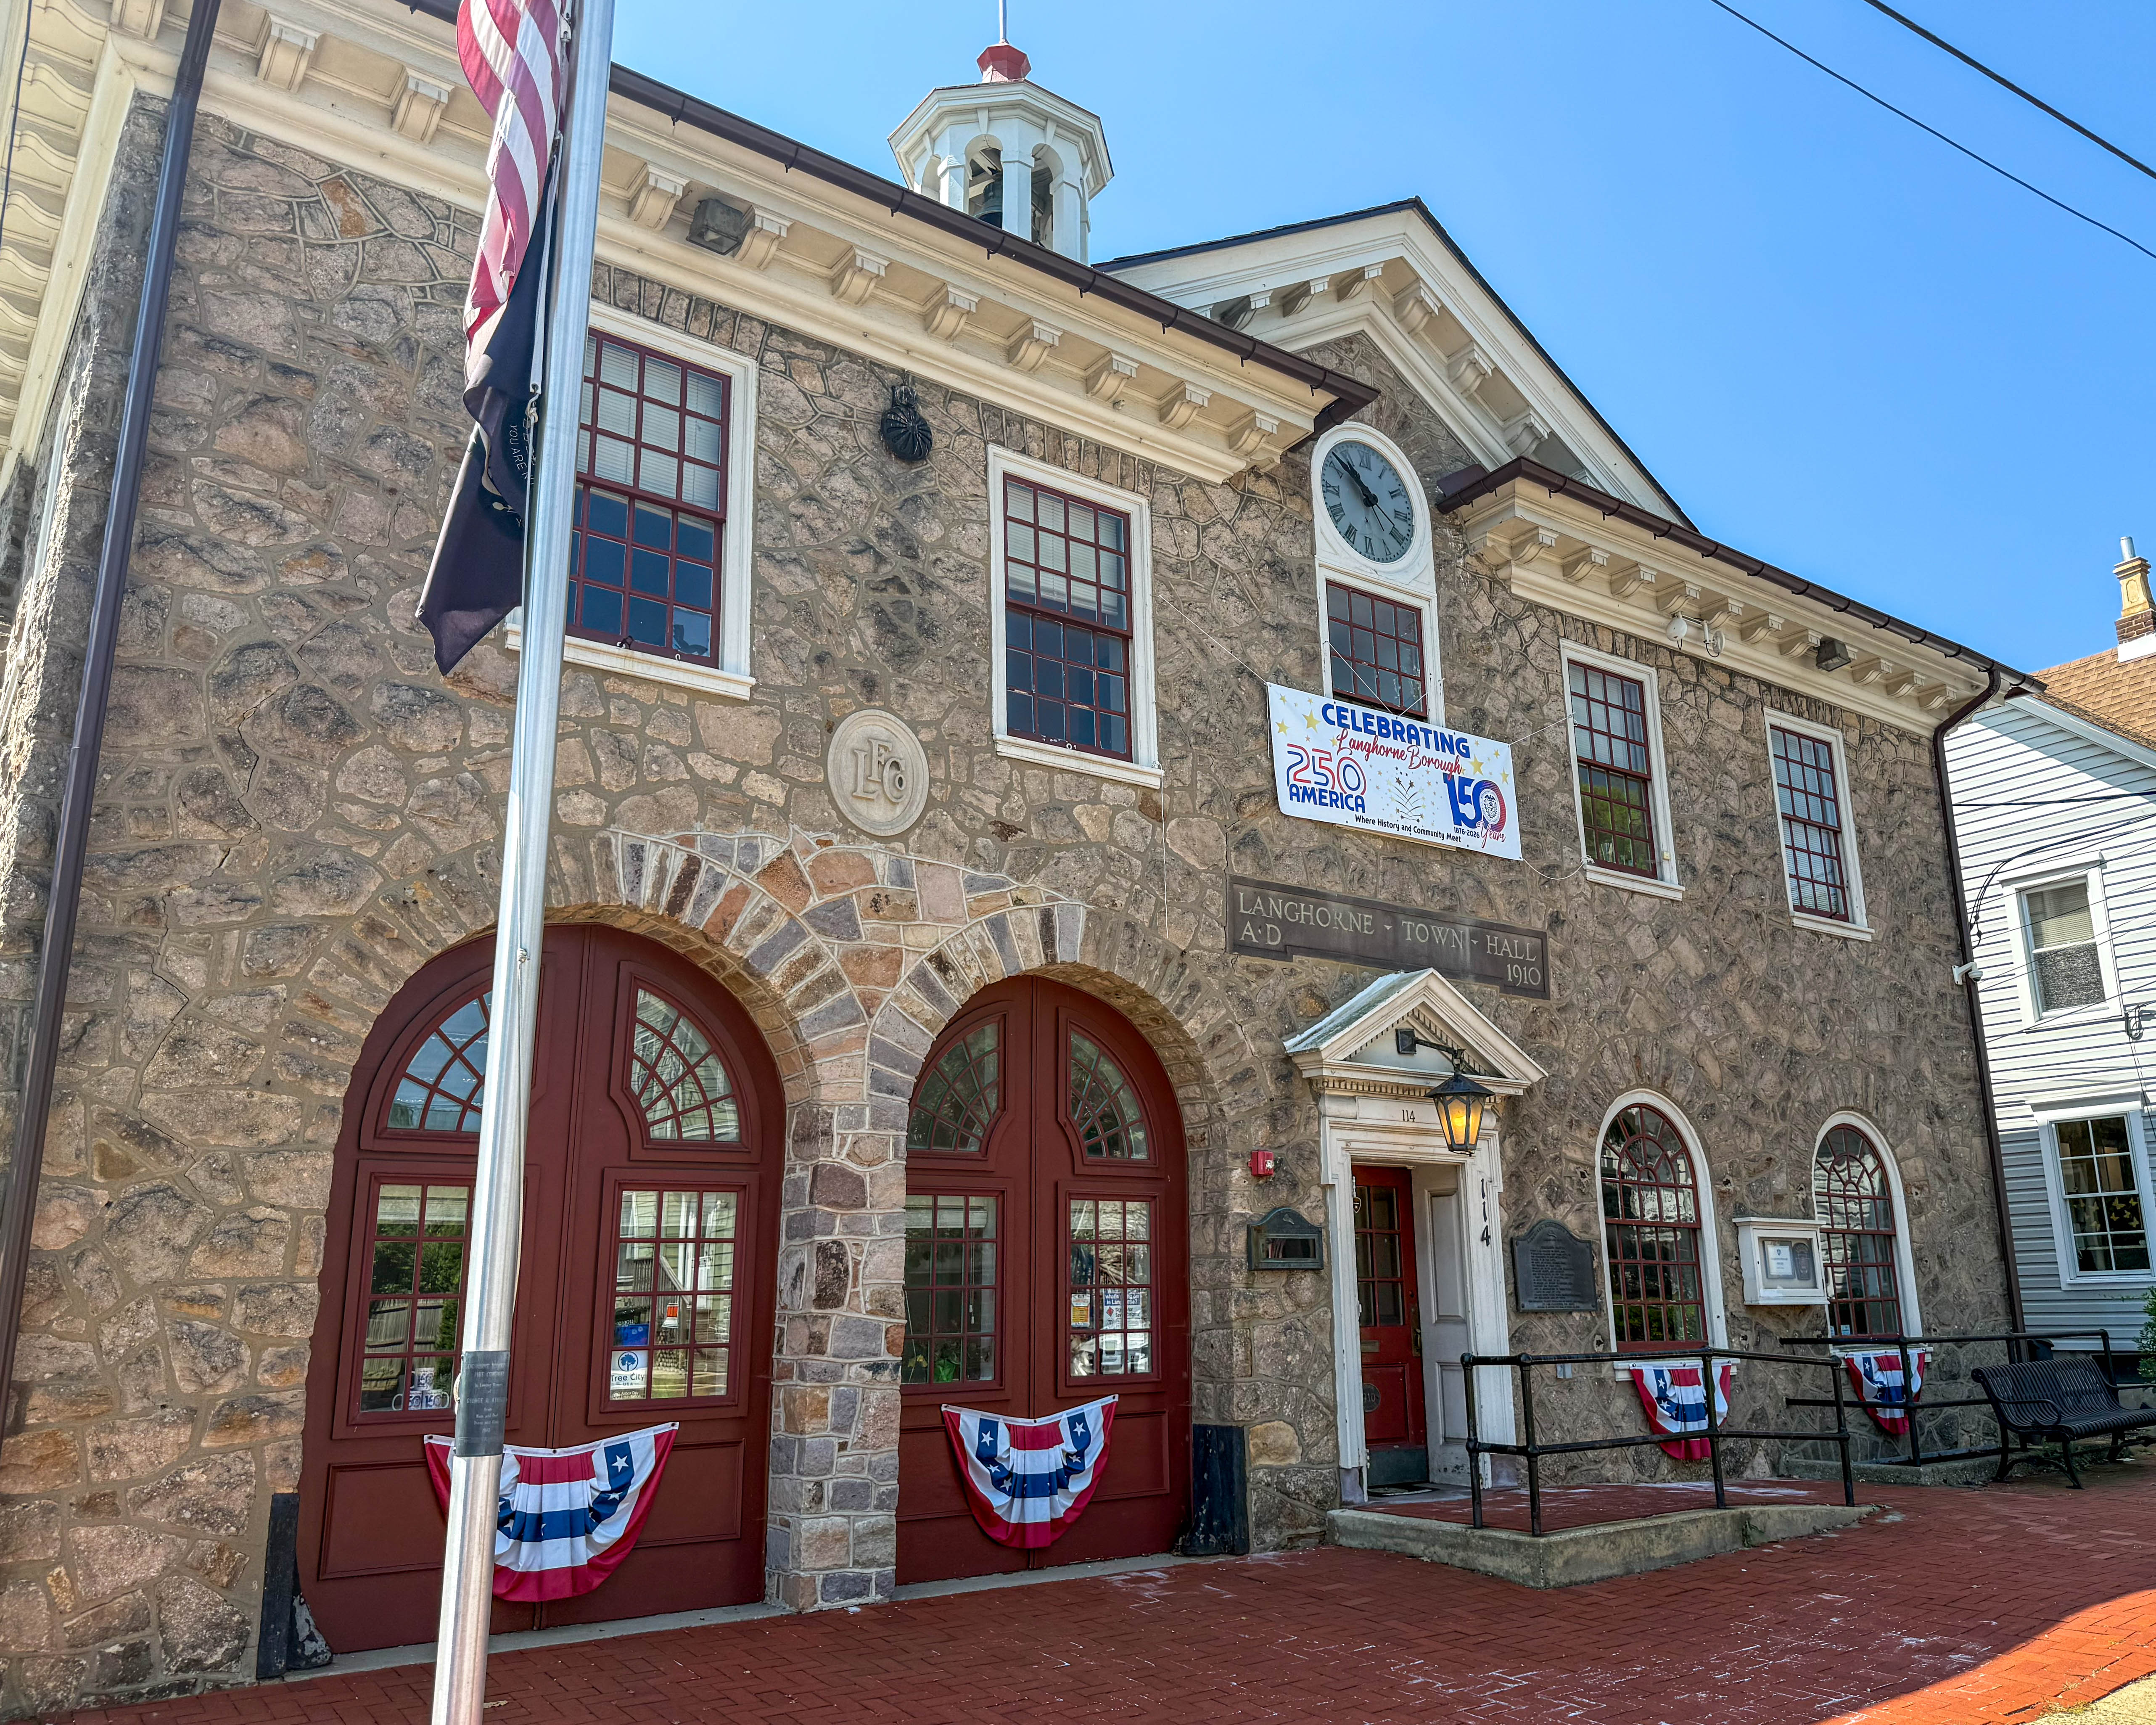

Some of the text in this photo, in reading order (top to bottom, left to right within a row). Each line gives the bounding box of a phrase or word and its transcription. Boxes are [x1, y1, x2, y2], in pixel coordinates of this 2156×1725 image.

[509, 425, 527, 470] YOU ARE
[1321, 703, 1471, 759] CELEBRATING
[1287, 743, 1367, 795] 250
[1336, 728, 1463, 781] Langhorne Borough
[1289, 783, 1366, 813] AMERICA
[1443, 772, 1506, 829] 150
[1355, 814, 1376, 825] Where
[1377, 818, 1400, 831] History
[1414, 826, 1445, 841] Community
[1446, 833, 1461, 843] Meet
[1476, 820, 1506, 849] Years
[1239, 892, 1537, 962] LANGHORNE TOWN HALL
[1506, 963, 1541, 987] 1910
[1402, 1109, 1416, 1122] 114
[1472, 1178, 1491, 1247] 114
[630, 1373, 645, 1381] City
